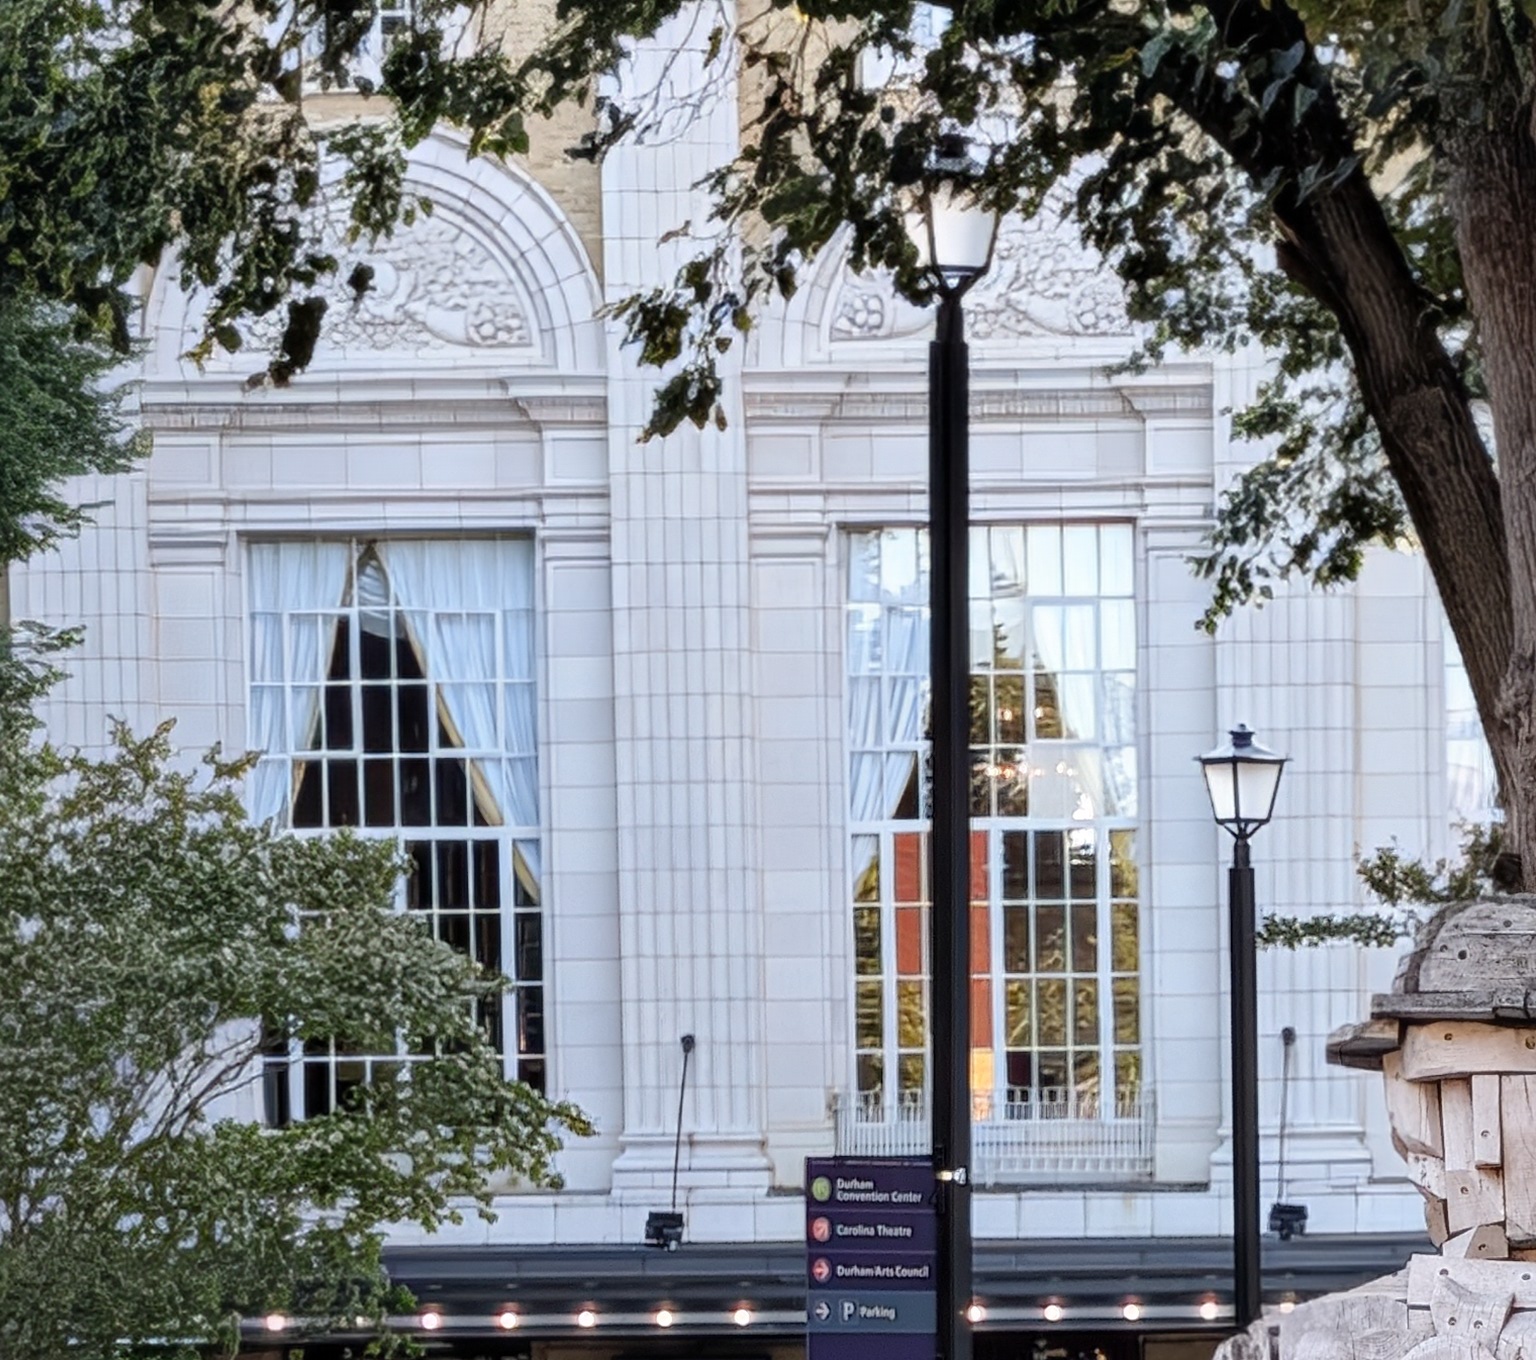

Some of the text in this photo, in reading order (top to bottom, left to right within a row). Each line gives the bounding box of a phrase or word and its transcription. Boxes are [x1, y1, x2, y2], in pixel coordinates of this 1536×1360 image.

[837, 1178, 873, 1190] Durham
[837, 1191, 922, 1203] Convention Center
[837, 1225, 912, 1238] Carolina Theatre
[837, 1265, 929, 1278] Durham Arts Council
[860, 1306, 896, 1320] Parking
